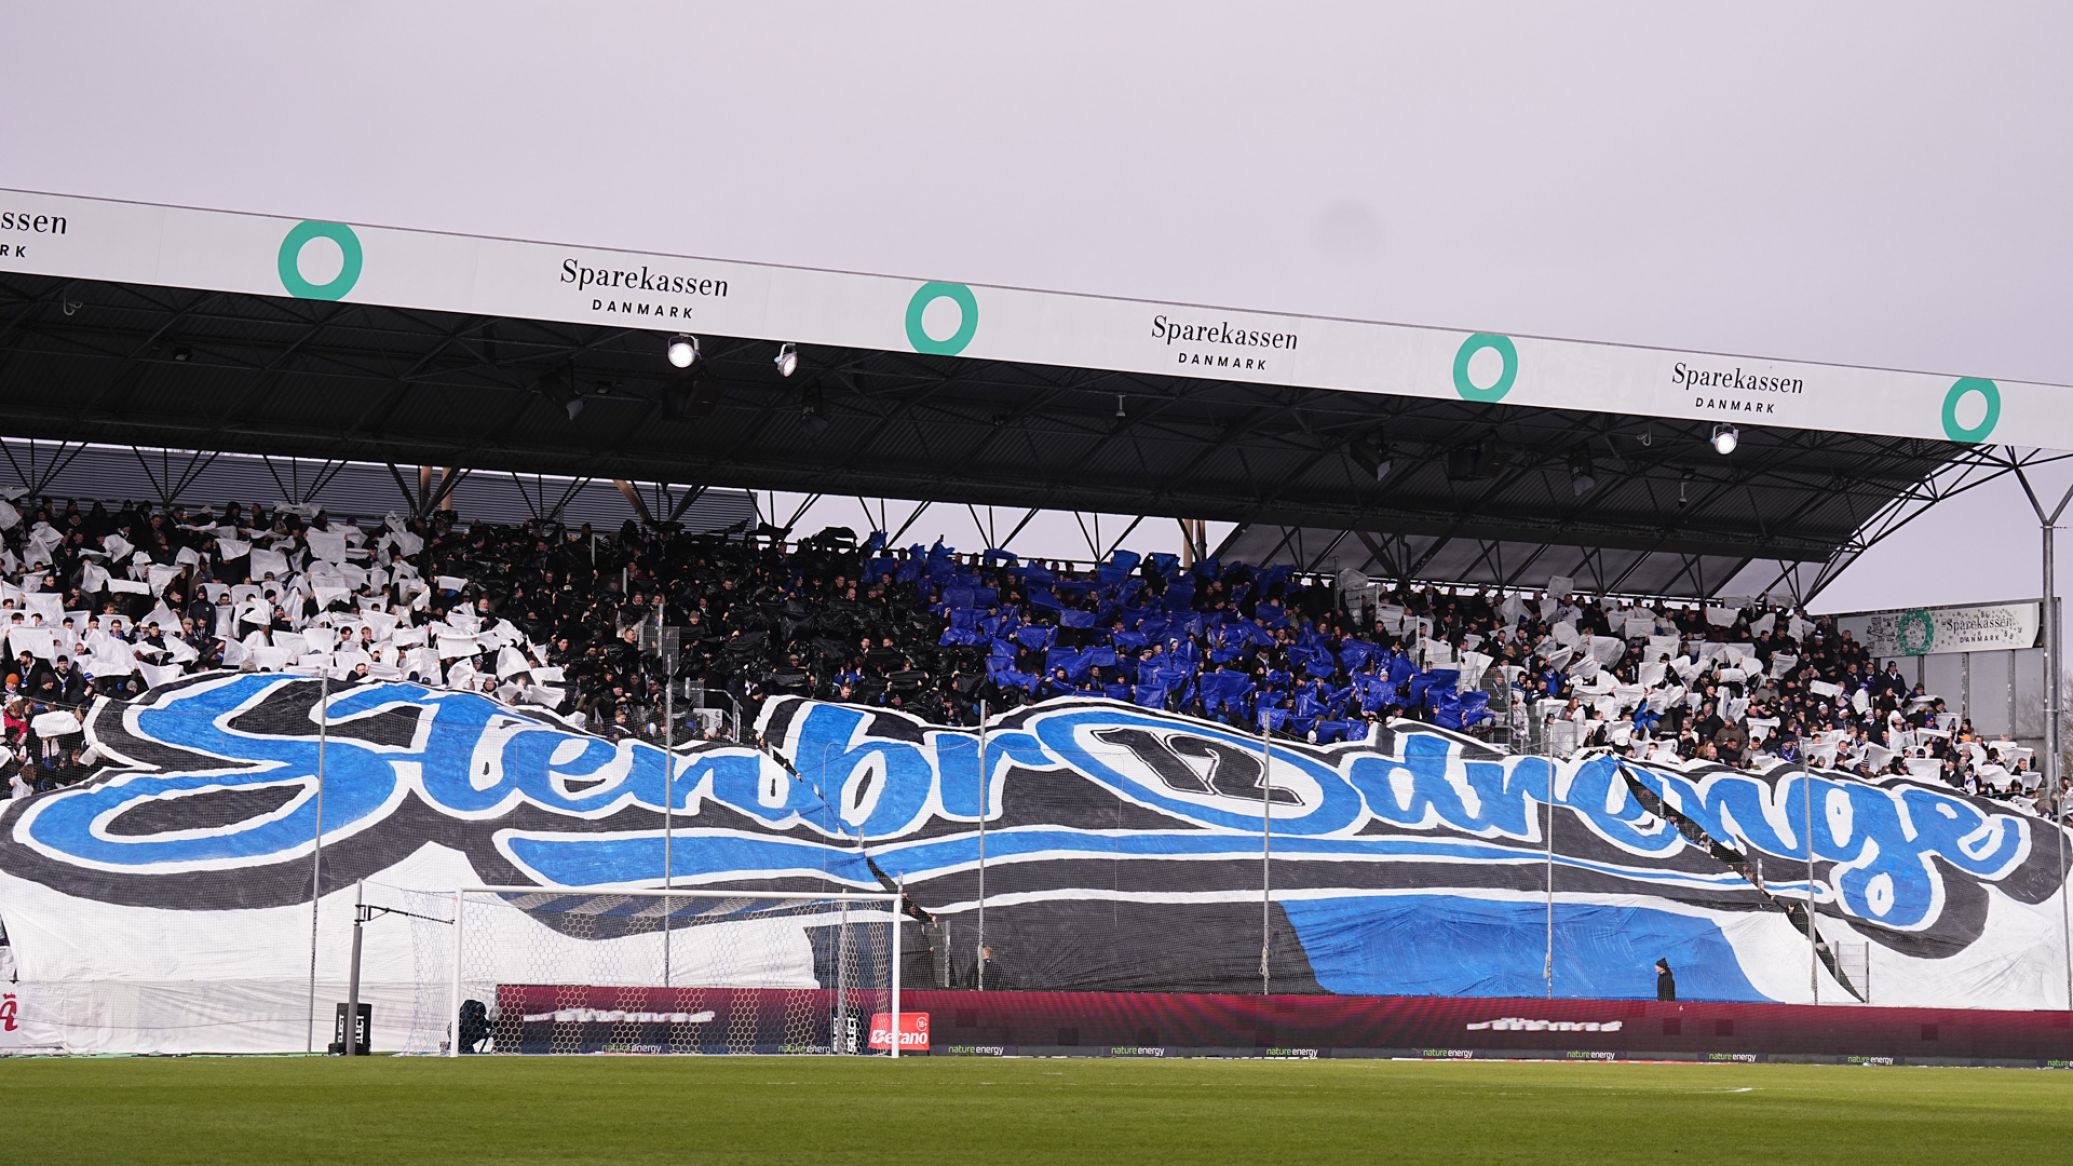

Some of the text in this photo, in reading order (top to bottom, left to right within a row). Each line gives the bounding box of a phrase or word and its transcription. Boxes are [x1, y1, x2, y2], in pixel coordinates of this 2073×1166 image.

[560, 258, 728, 297] Sparekassen
[592, 299, 693, 319] DANMARK
[1151, 315, 1298, 350] Sparekassen
[1178, 352, 1266, 370] DANMARK
[1672, 362, 1803, 394] Sparekassen
[1695, 397, 1775, 413] DANMARK
[1090, 727, 1306, 806] 12
[355, 1015, 364, 1044] ELECT
[848, 1017, 856, 1052] SELECT
[871, 1030, 928, 1044] Beano
[976, 1046, 1003, 1056] energy
[1138, 1047, 1165, 1057] energy
[1292, 1048, 1318, 1058] energy
[1448, 1049, 1473, 1058] energy
